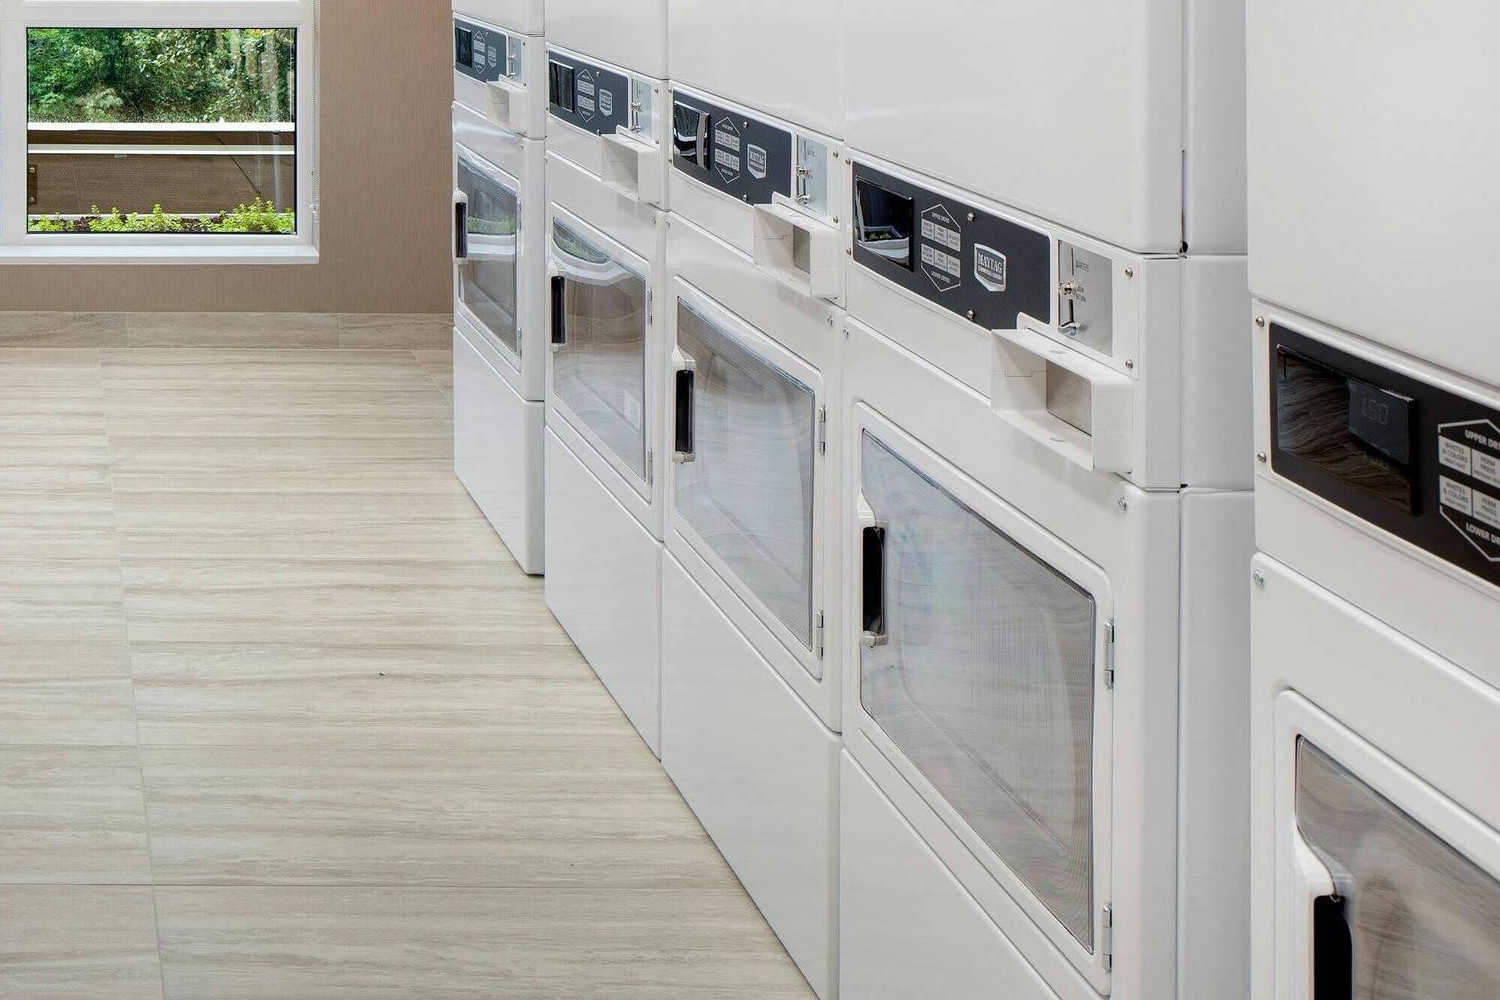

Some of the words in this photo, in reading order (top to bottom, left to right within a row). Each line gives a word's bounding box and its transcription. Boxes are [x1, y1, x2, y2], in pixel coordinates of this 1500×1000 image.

[978, 252, 1002, 273] MAYTAG
[1465, 429, 1487, 446] UPPER
[1445, 442, 1464, 454] WHITES
[1447, 450, 1468, 463] COLORS
[1481, 456, 1495, 466] PERM
[1480, 463, 1496, 475] PRESS
[1446, 483, 1466, 494] WHITES
[1449, 490, 1468, 503] COLORS
[1466, 522, 1490, 541] LOWER
